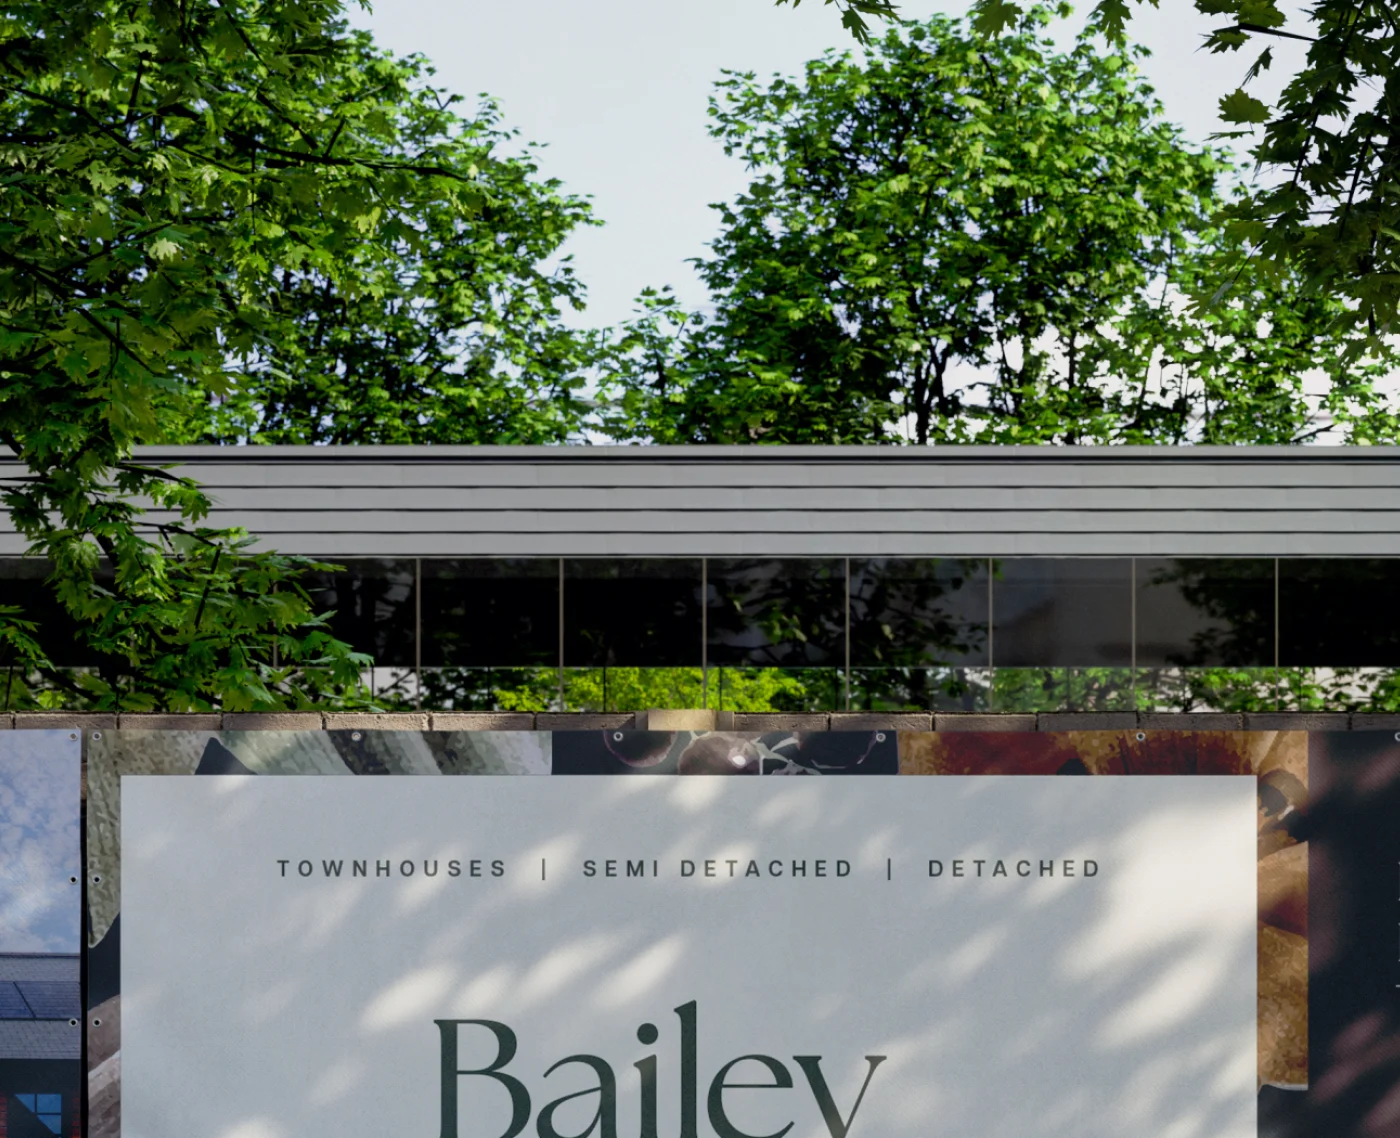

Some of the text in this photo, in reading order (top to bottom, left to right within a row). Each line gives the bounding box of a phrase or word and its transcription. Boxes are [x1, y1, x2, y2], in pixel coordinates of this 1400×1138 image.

[276, 859, 1099, 878] TOWNHOUSES SEMI DETACHED DETACHED
